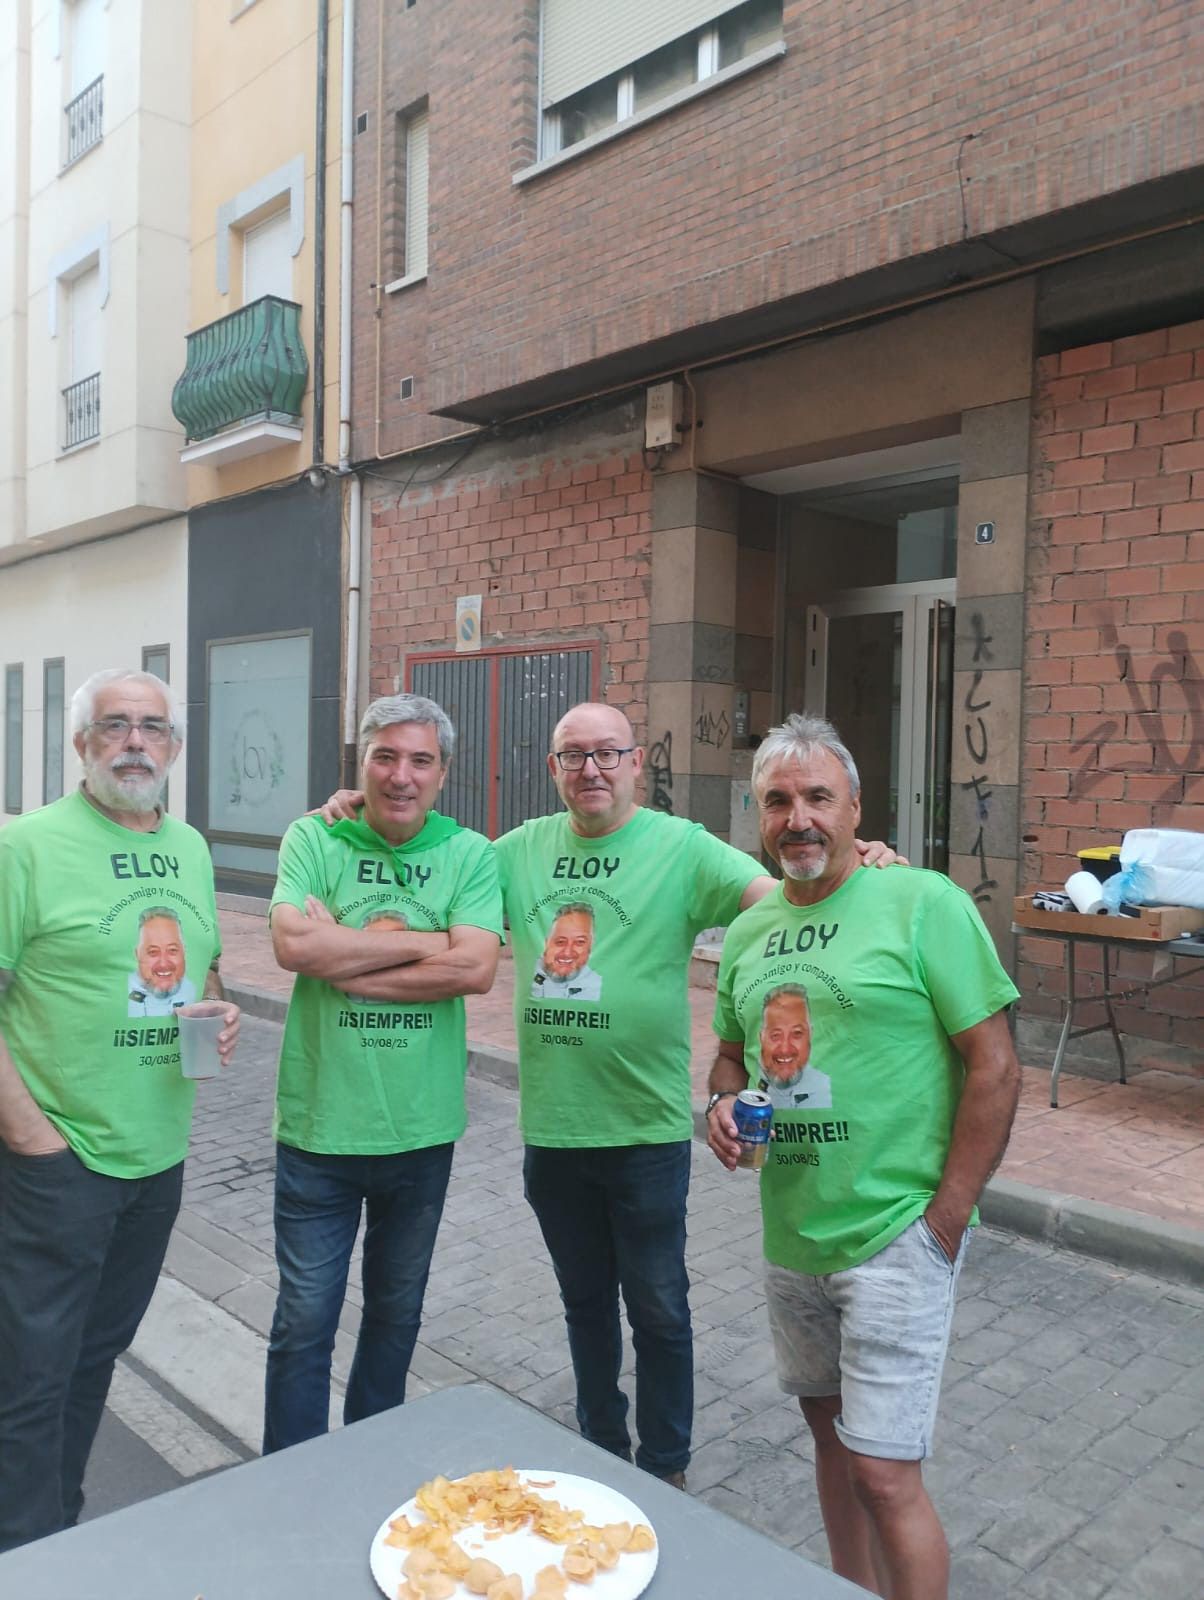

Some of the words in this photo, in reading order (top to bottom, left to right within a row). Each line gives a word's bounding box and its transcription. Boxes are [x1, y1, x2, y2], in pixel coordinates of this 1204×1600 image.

[982, 526, 988, 540] 4
[110, 852, 179, 880] ELOY
[552, 857, 620, 880] ELOY
[158, 887, 164, 897] y
[393, 895, 400, 904] y
[401, 895, 441, 931] compañero
[763, 923, 839, 958] ELOY
[794, 963, 800, 974] y
[361, 1037, 408, 1049] 30/08/25
[540, 1033, 584, 1046] 30/08/25
[775, 1153, 820, 1168] 30/08/25
